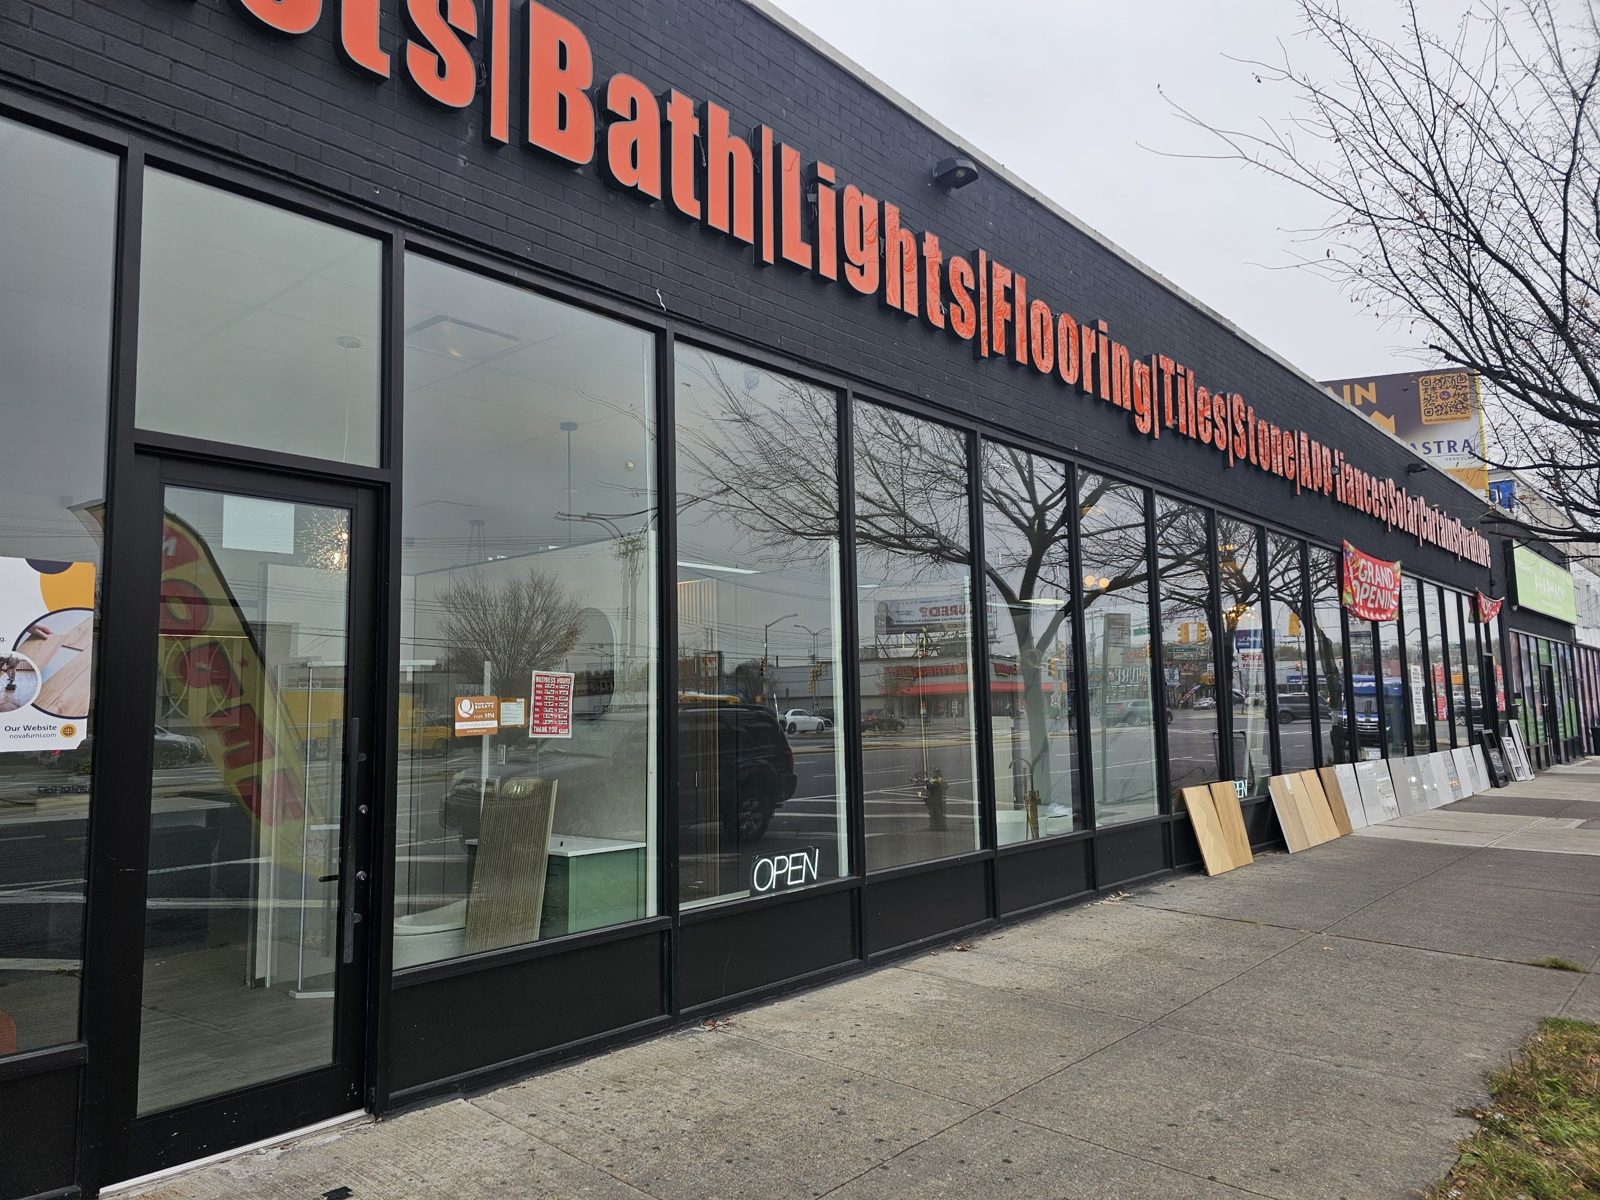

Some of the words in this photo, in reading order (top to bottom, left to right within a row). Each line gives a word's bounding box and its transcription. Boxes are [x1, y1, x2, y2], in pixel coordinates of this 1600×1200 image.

[1328, 381, 1377, 406] IN
[1358, 558, 1394, 589] GRAND
[753, 848, 820, 892] OPEN
